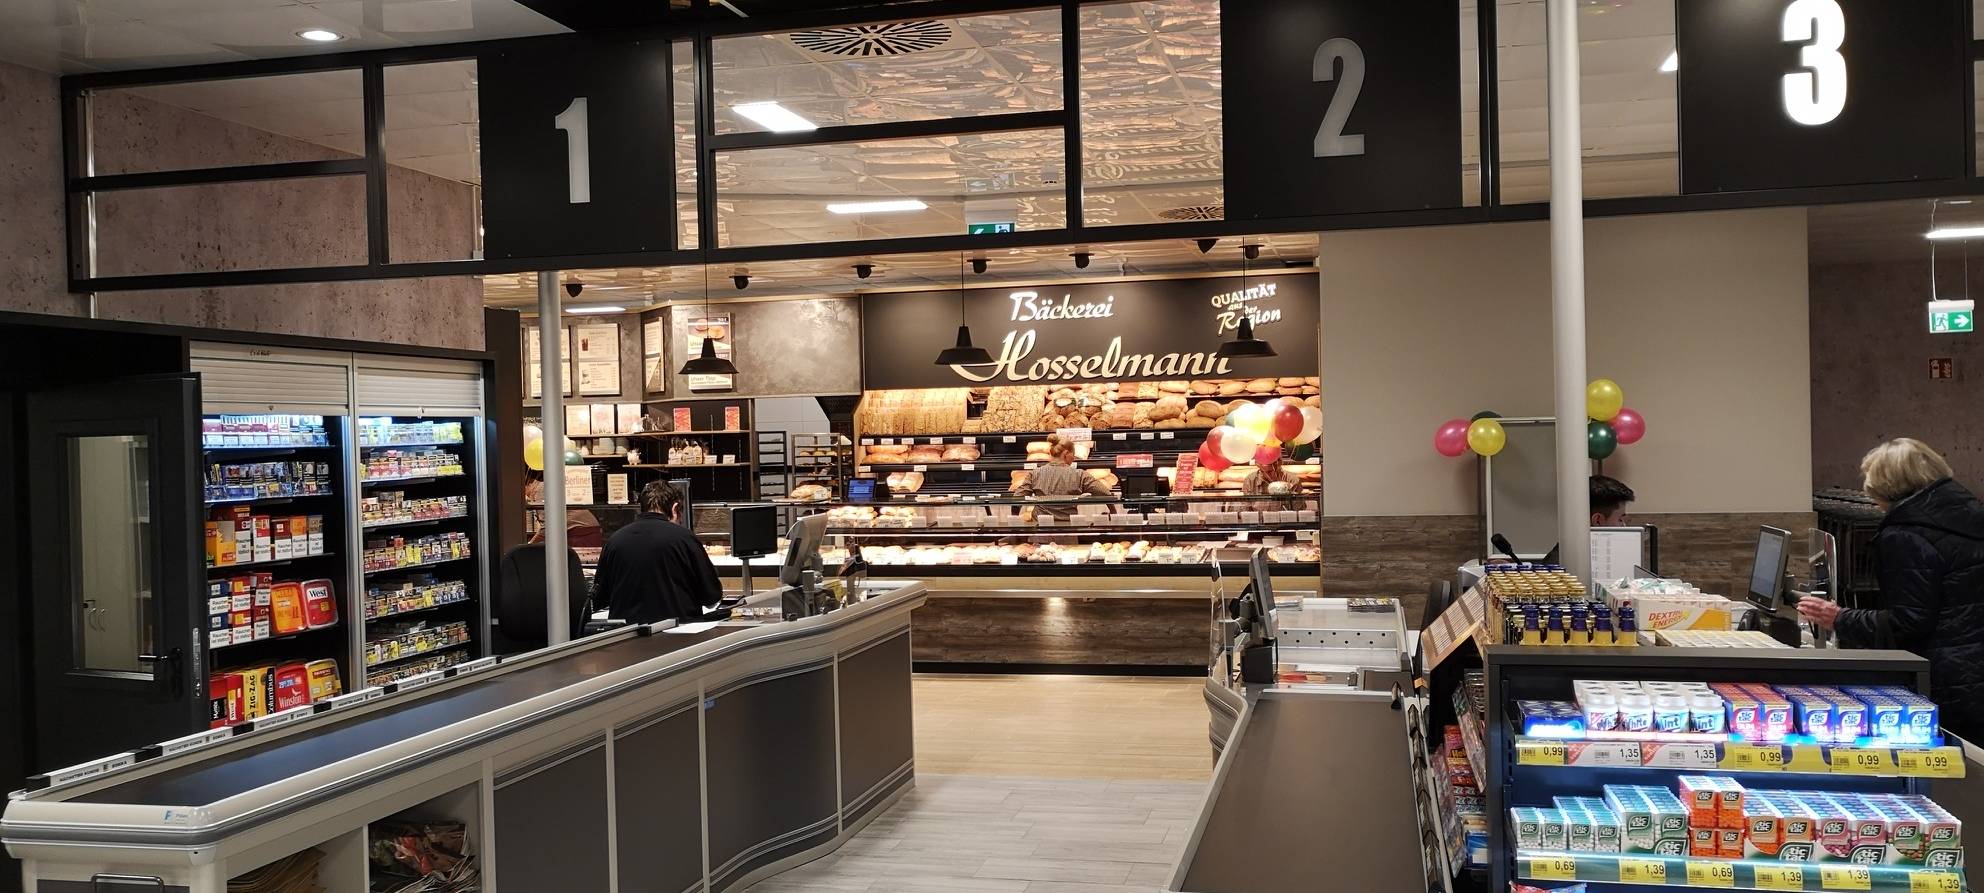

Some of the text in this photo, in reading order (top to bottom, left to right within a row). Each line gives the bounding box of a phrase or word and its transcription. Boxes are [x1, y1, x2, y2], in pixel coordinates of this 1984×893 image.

[1783, 0, 1847, 125] 3
[1313, 37, 1365, 157] 2
[555, 97, 590, 203] 1
[1211, 283, 1277, 308] QUALITÄT
[1009, 291, 1114, 321] Bäckerei
[951, 329, 1233, 382] Hosselmann
[307, 589, 327, 598] West
[278, 694, 304, 709] Winston
[1544, 746, 1562, 756] 0,99
[1620, 748, 1639, 758] 1,35
[1694, 750, 1715, 760] 1,35
[1760, 752, 1781, 763] 0,99
[1858, 754, 1879, 766] 0,99
[1925, 756, 1947, 768] 0,99
[1664, 841, 1682, 850] tic
[1790, 846, 1808, 855] tic
[1785, 853, 1806, 862] tac
[1861, 849, 1880, 858] tic
[1936, 852, 1956, 861] tic
[1857, 856, 1878, 864] tac
[1932, 860, 1953, 868] tac
[1555, 860, 1575, 872] 0,69
[1644, 864, 1665, 876] 1,39
[1712, 867, 1732, 878] 0,69
[1781, 871, 1802, 882] 1,39
[1848, 869, 1868, 880] 1,39
[1938, 879, 1960, 890] 1,39
